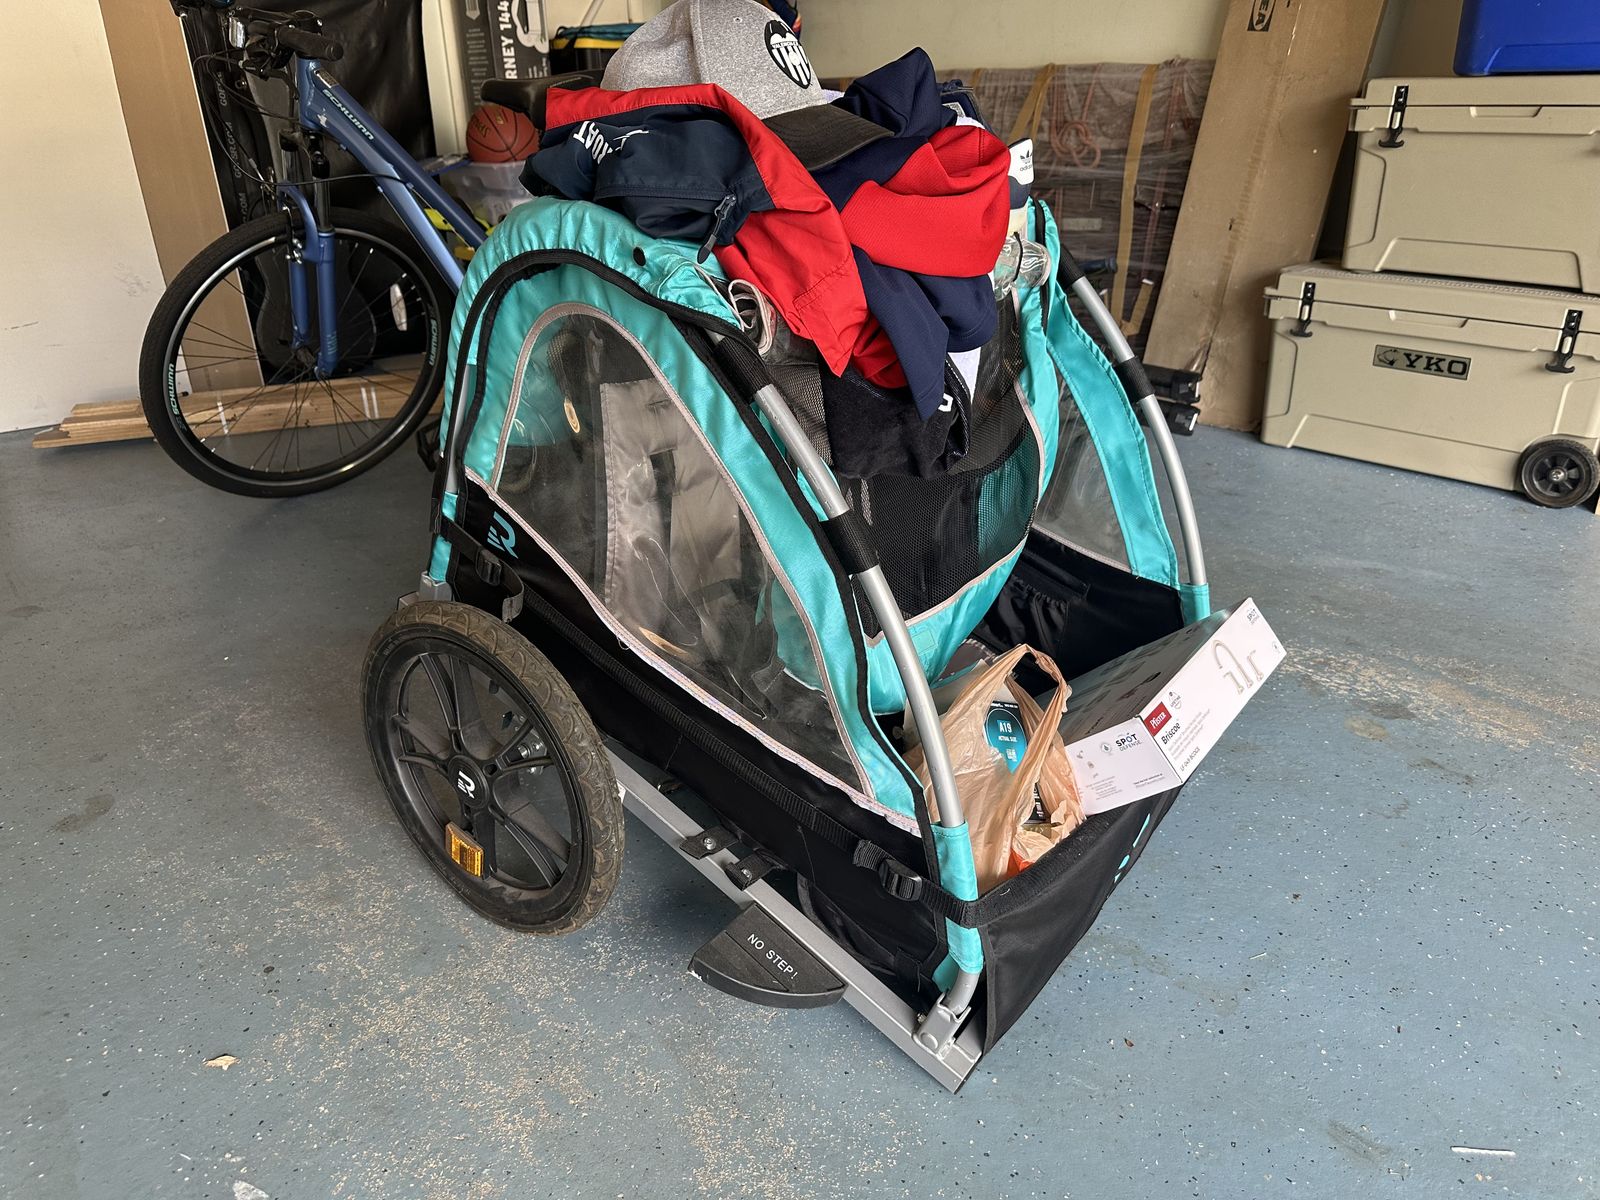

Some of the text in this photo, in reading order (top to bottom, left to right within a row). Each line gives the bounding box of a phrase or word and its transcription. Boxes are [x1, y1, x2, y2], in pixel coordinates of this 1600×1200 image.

[497, 0, 512, 30] 144
[323, 89, 374, 140] SCHWINN
[1403, 352, 1468, 375] YKO
[168, 363, 180, 415] SCHWINN
[999, 721, 1012, 733] A19
[1115, 733, 1138, 747] SPOT
[1161, 722, 1181, 745] Briscoe
[747, 933, 798, 979] NO STEP!
